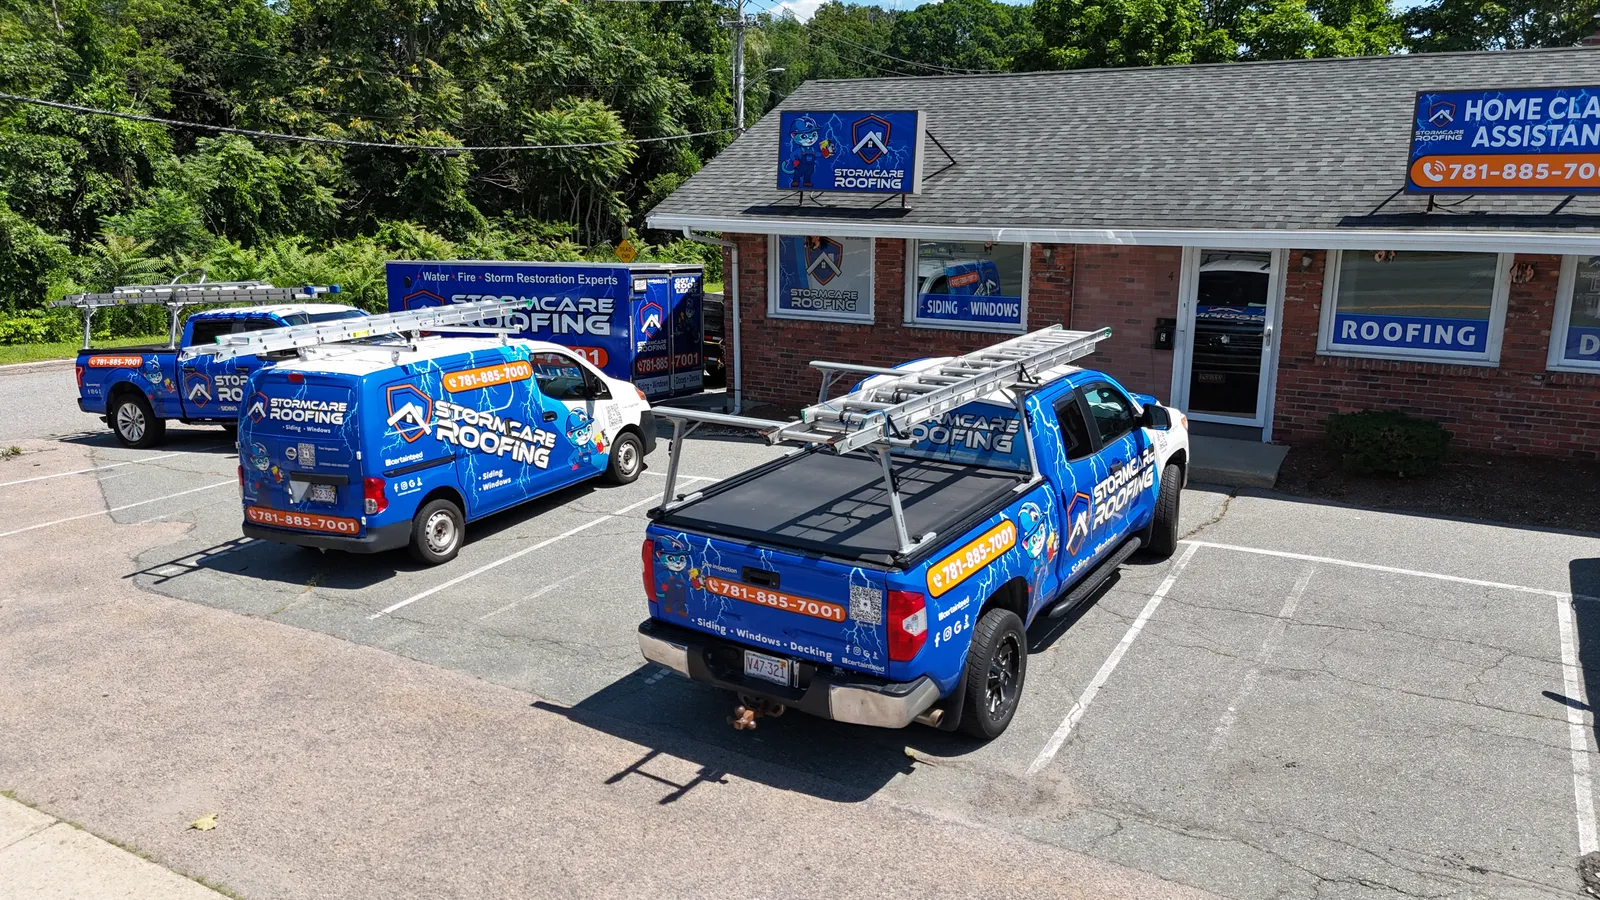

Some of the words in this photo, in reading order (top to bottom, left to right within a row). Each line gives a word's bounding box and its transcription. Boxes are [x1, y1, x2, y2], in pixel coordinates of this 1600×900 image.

[1465, 98, 1542, 122] HOME
[834, 169, 904, 178] STORMCARE
[1449, 163, 1600, 180] 781-885-70
[834, 177, 902, 189] ROOFING
[422, 271, 449, 282] Water
[457, 272, 476, 282] Fire
[484, 272, 514, 283] Storm
[516, 273, 576, 285] Restoration
[578, 274, 618, 286] Experts
[790, 288, 858, 299] STORMCARE
[791, 297, 857, 311] ROOFING
[927, 300, 958, 314] SIDING
[970, 302, 1019, 317] WINDOWS
[1341, 320, 1476, 346] ROOFING
[637, 344, 667, 353] ROOFING
[96, 358, 140, 366] 781-885-7001
[458, 364, 529, 388] 781-885-7001
[270, 398, 348, 412] STORMCARE
[270, 408, 344, 425] ROOFING
[435, 400, 557, 448] STORMCARE
[285, 424, 301, 432] Siding
[306, 426, 331, 434] Windows
[435, 418, 551, 470] ROOFING
[390, 451, 423, 465] certainteed
[482, 469, 503, 480] Siding
[1093, 447, 1155, 505] STORMCARE
[482, 477, 511, 491] Windows
[1093, 465, 1154, 530] ROOFING
[257, 511, 355, 532] 781-885-7001
[941, 526, 1014, 585] 781-885-7001
[721, 582, 842, 620] 781-885-7001
[697, 617, 727, 635] Siding
[736, 628, 781, 647] Windows
[790, 641, 833, 663] Decking
[847, 659, 885, 672] certainteed
